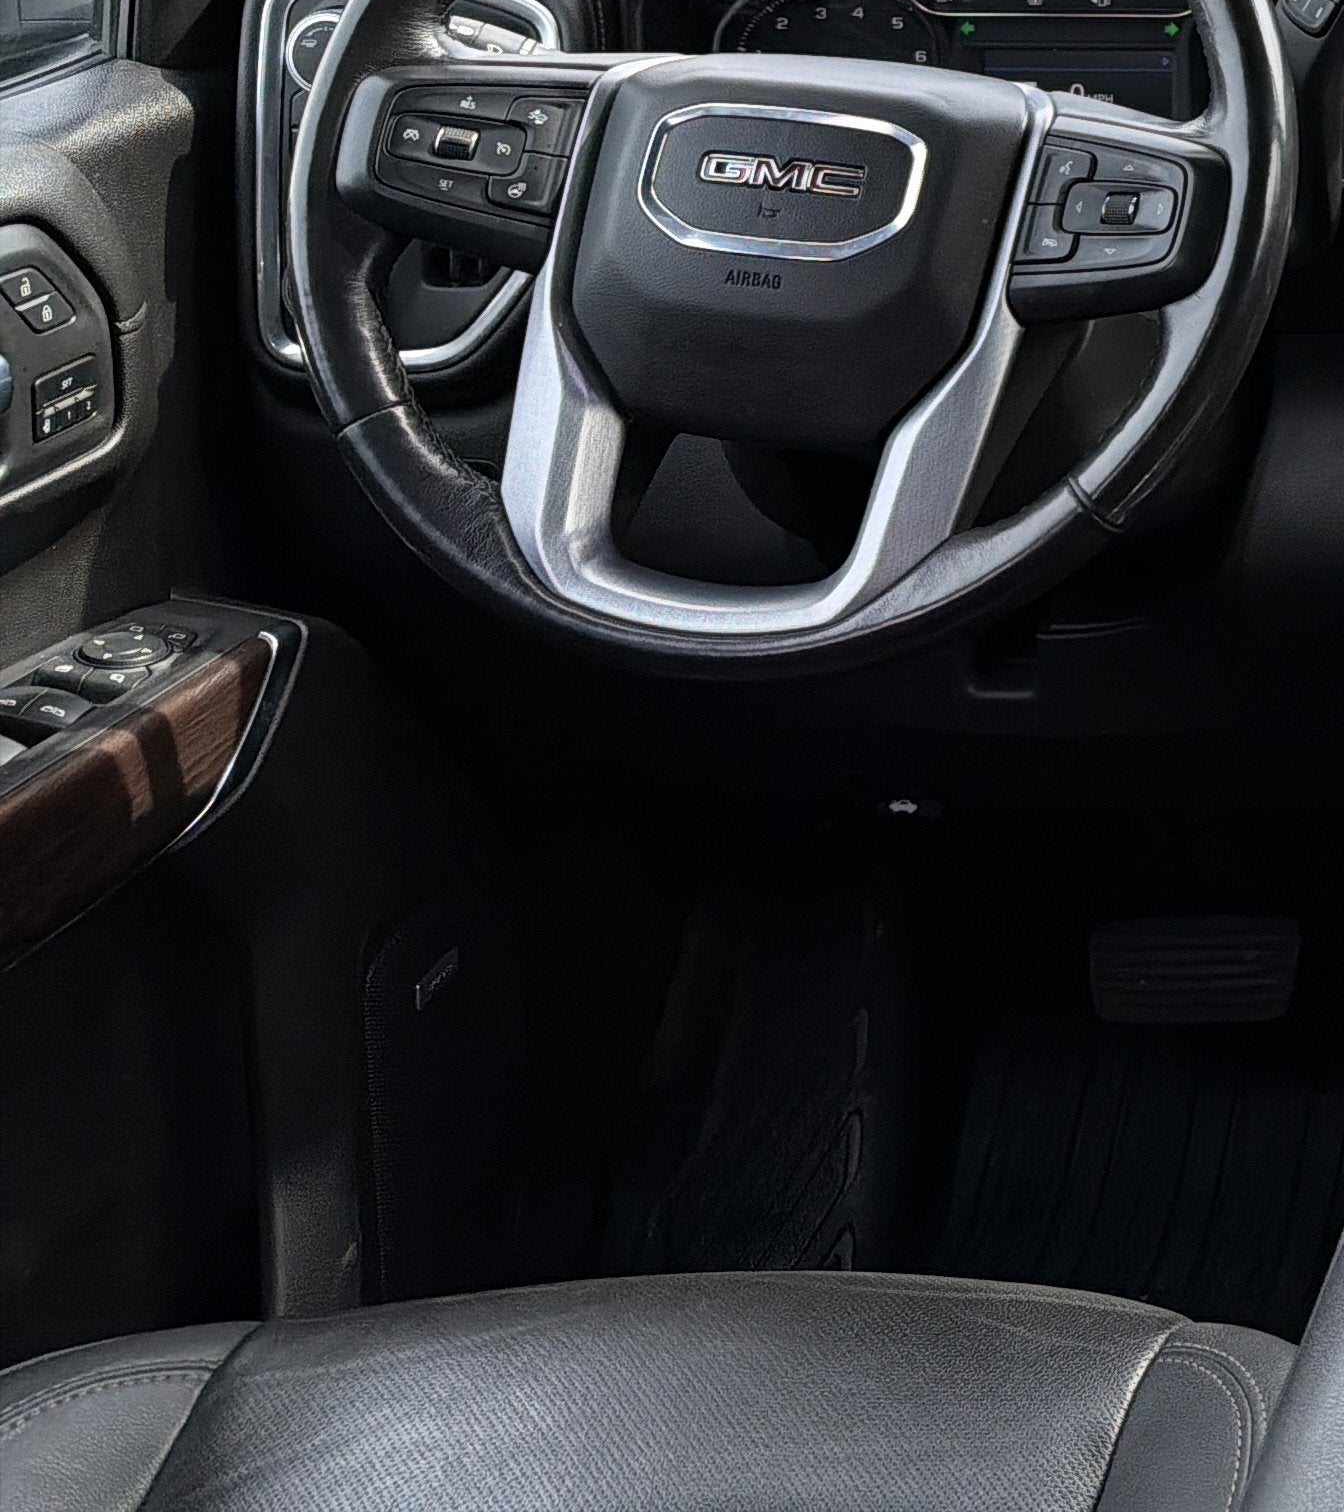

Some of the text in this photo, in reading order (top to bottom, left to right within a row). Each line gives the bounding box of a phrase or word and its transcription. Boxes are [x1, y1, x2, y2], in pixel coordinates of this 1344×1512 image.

[816, 8, 828, 20] 3
[852, 7, 864, 19] 4
[775, 17, 789, 30] 2
[891, 17, 904, 30] 5
[915, 50, 928, 63] 6
[459, 99, 477, 110] RES
[700, 151, 868, 199] GMC
[724, 269, 782, 290] AIRBAG
